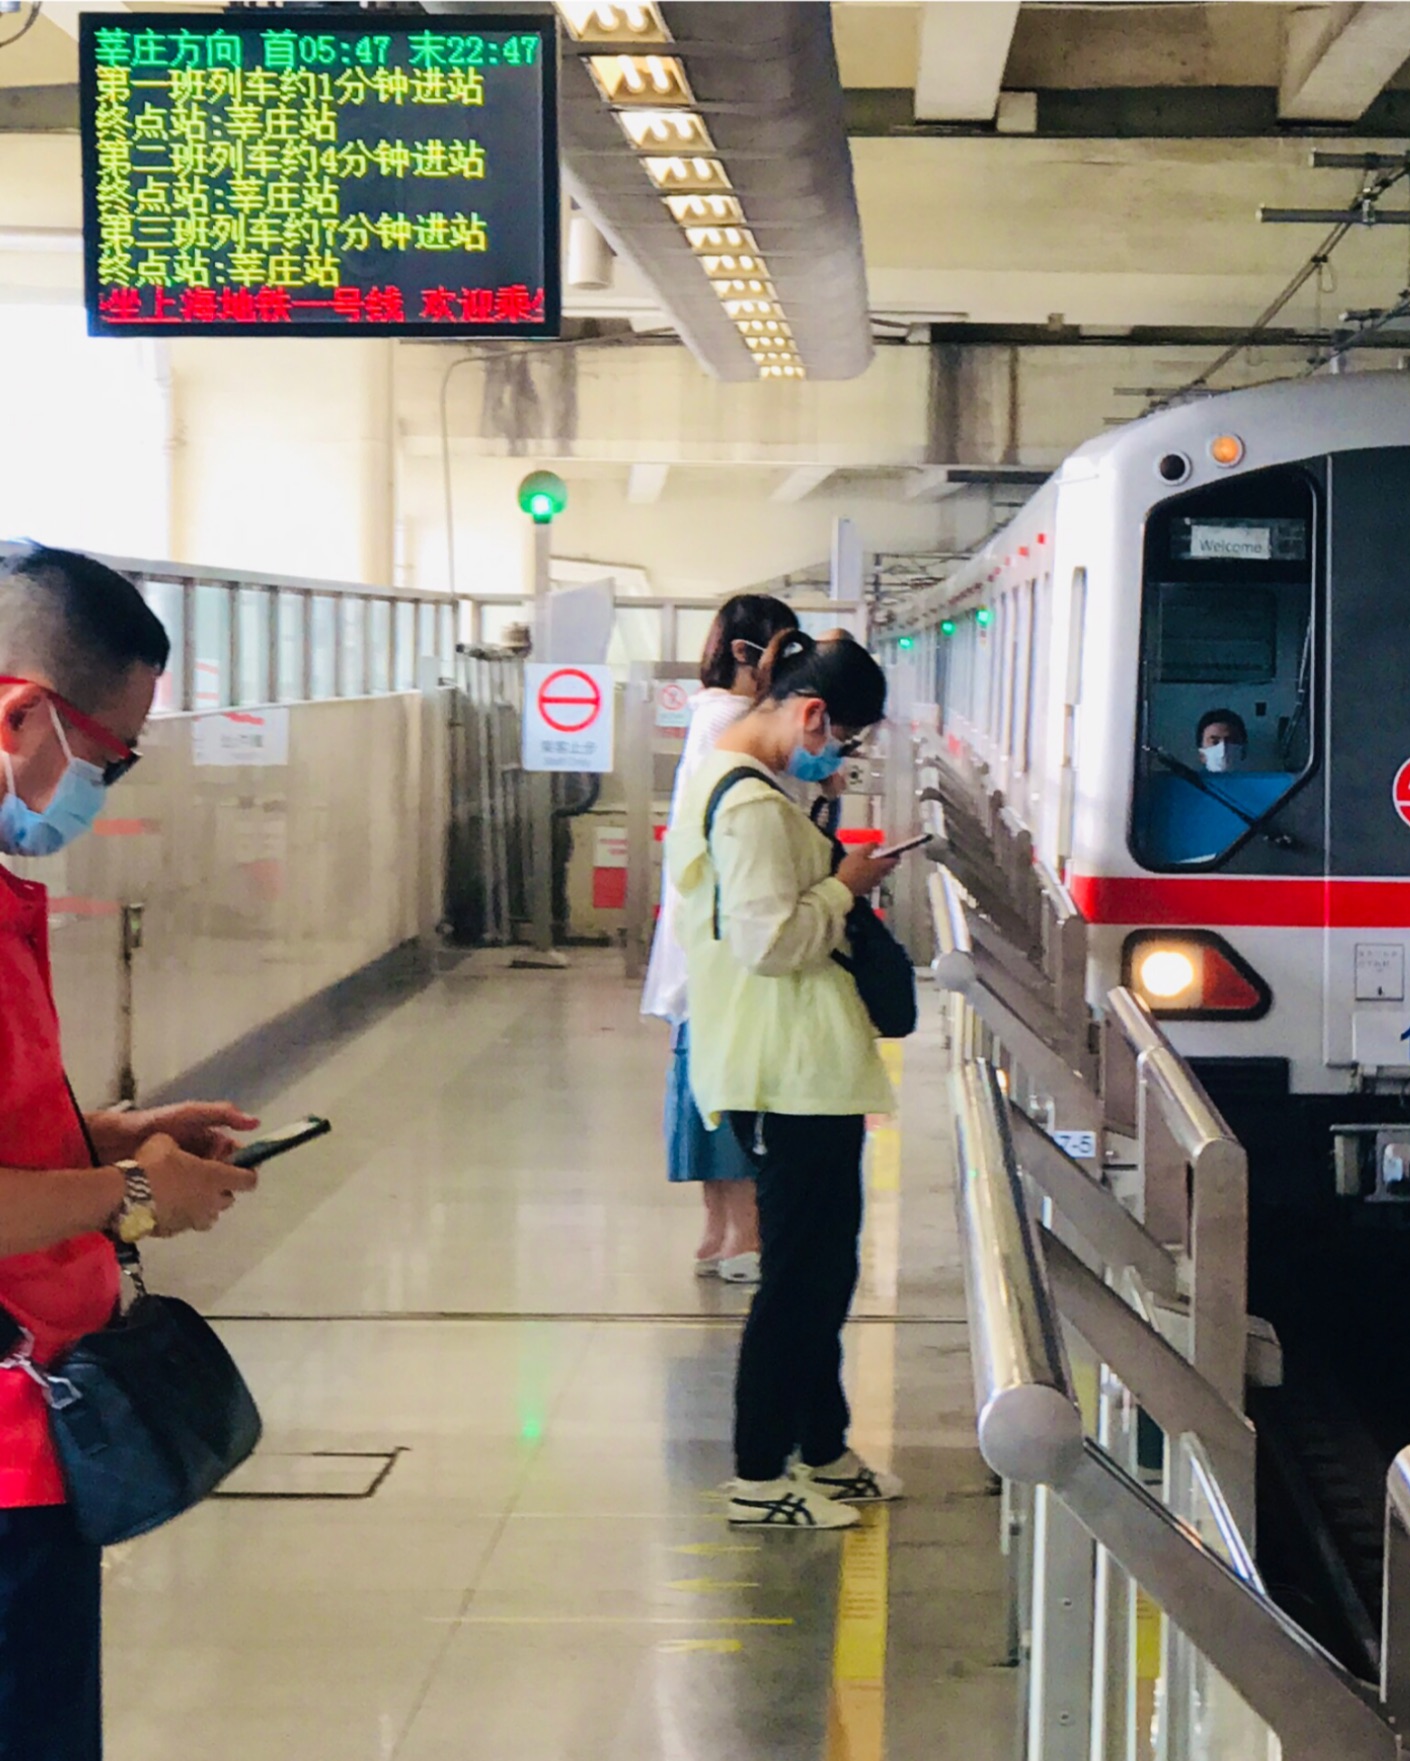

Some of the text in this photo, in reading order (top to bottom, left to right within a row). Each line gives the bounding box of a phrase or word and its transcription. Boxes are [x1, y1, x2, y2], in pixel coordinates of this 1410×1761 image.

[95, 27, 539, 67] 莘庄方向 首05:47 末22:47
[95, 65, 484, 104] 第一班列车约1分钟进站
[96, 140, 486, 178] 第二班列车约4分钟进站
[97, 212, 487, 252] 第三班列车约7分钟进站
[1200, 539, 1263, 554] Welcome
[1059, 1135, 1092, 1154] 7-5
